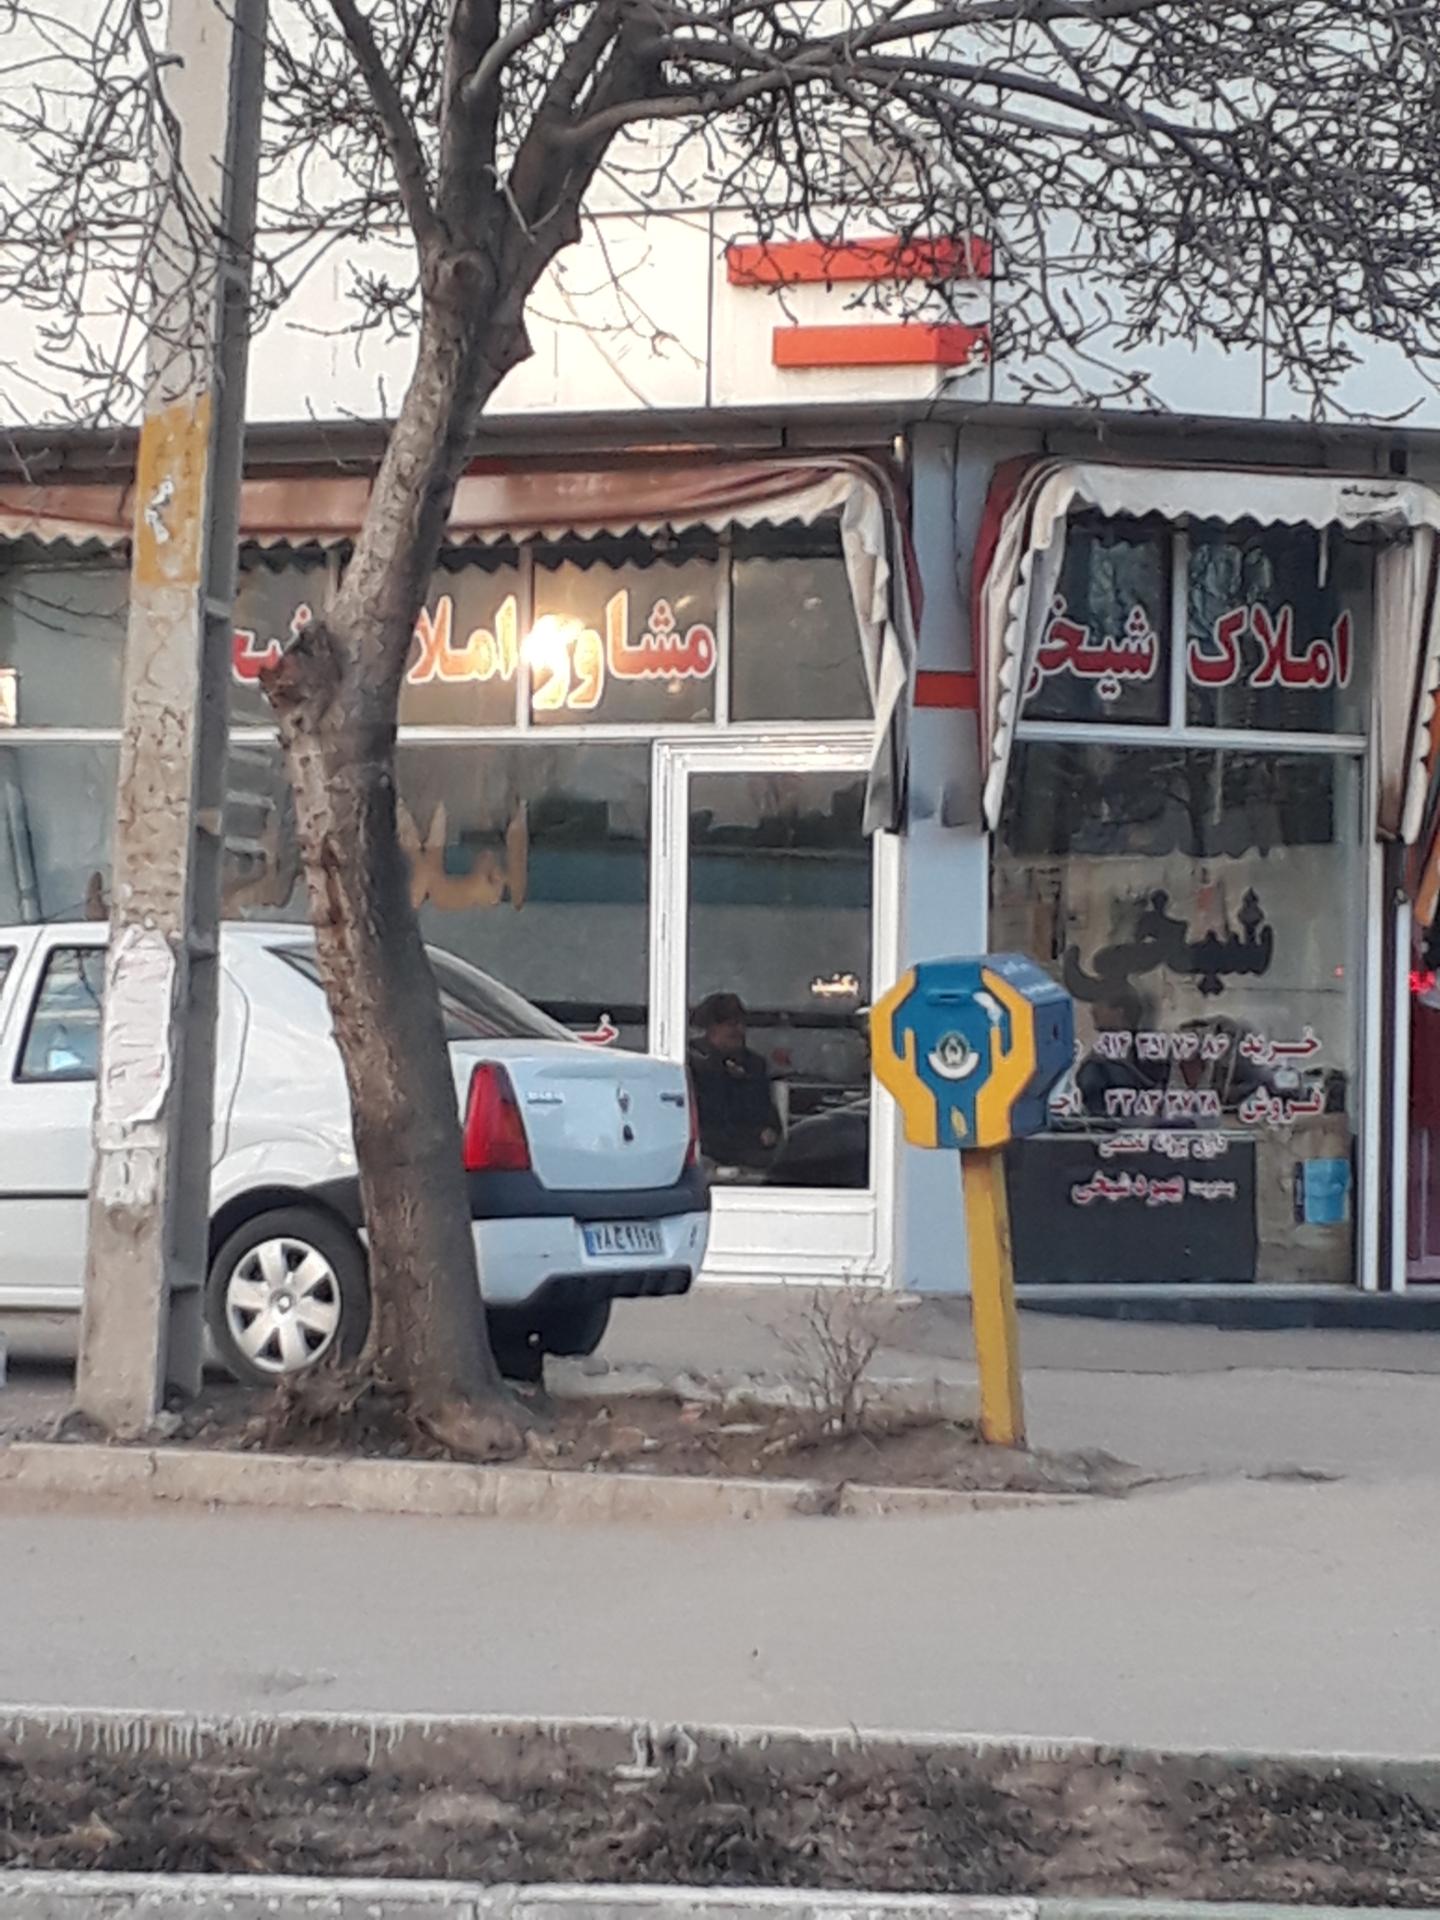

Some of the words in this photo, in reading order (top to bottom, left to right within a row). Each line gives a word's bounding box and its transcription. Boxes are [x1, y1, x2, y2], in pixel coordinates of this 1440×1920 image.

[406, 594, 518, 683] املا
[1022, 594, 1159, 701] شیخ
[1188, 602, 1354, 689] املاک
[1239, 1026, 1321, 1064] خرید
[1239, 1084, 1327, 1124] فروش
